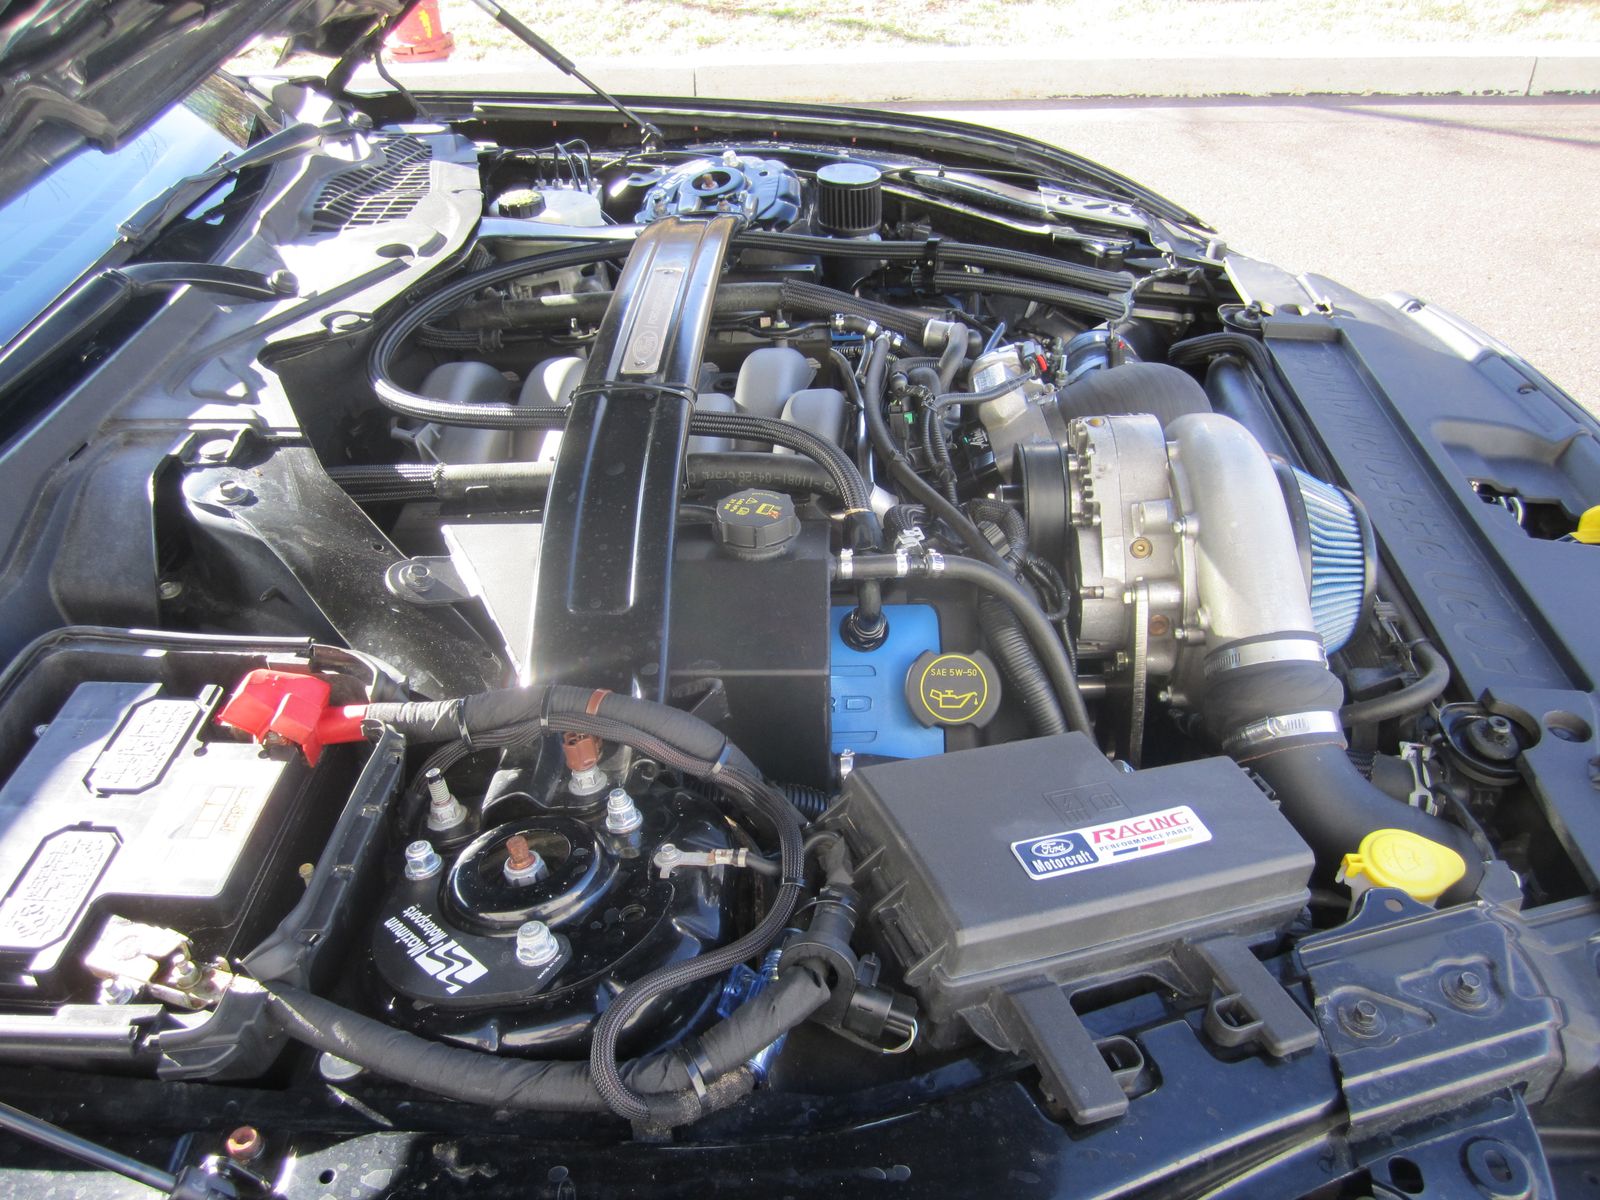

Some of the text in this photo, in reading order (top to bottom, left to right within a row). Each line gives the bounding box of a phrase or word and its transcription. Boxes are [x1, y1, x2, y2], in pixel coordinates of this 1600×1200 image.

[930, 668, 978, 677] SAE 5W-50
[1091, 811, 1190, 844] RACING
[1099, 826, 1195, 852] PERFORMANCE PARTS
[1032, 850, 1094, 873] Motorcraft
[384, 916, 430, 958] Maximum
[403, 905, 449, 945] Motorsports
